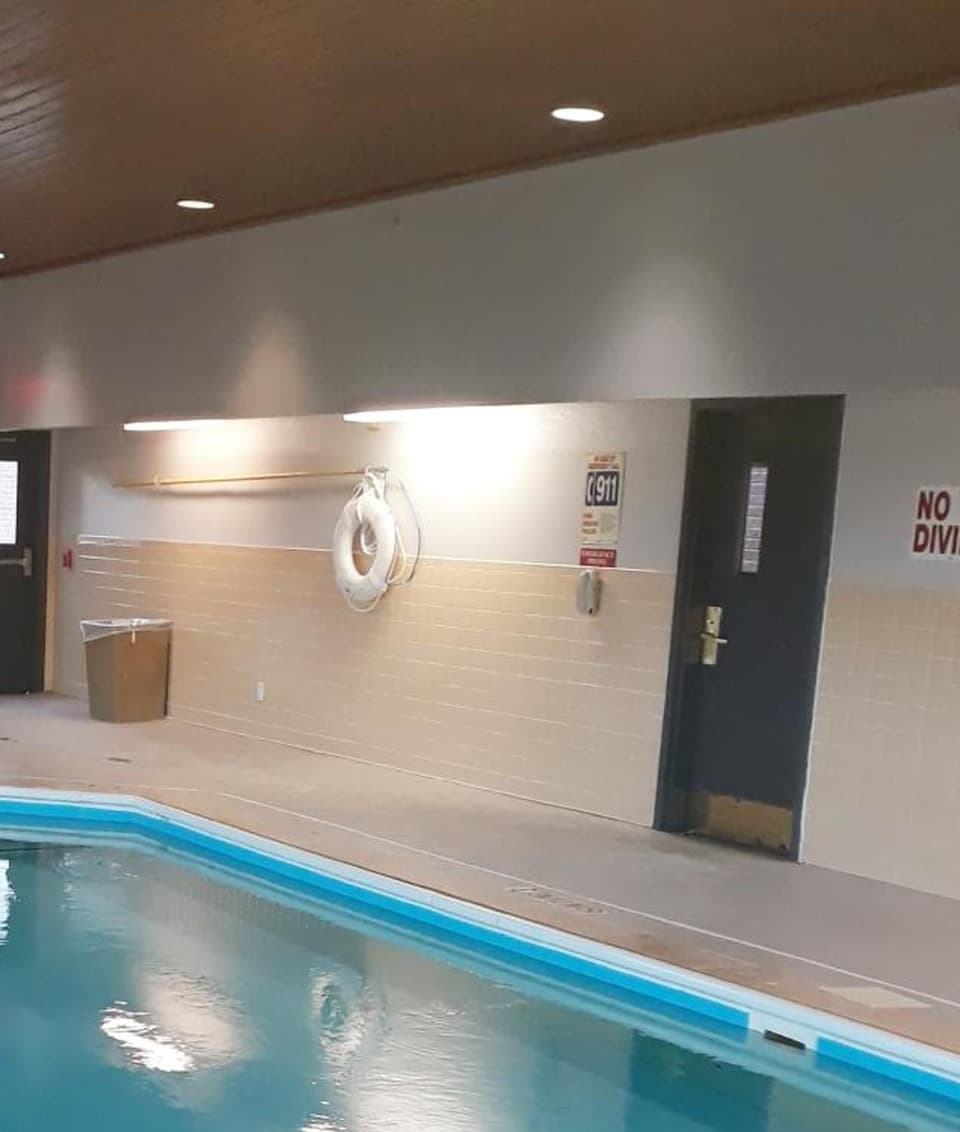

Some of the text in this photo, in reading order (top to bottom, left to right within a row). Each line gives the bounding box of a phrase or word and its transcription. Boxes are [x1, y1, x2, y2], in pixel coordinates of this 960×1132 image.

[596, 475, 617, 502] 911
[917, 491, 951, 520] NO
[912, 523, 960, 555] DIVI
